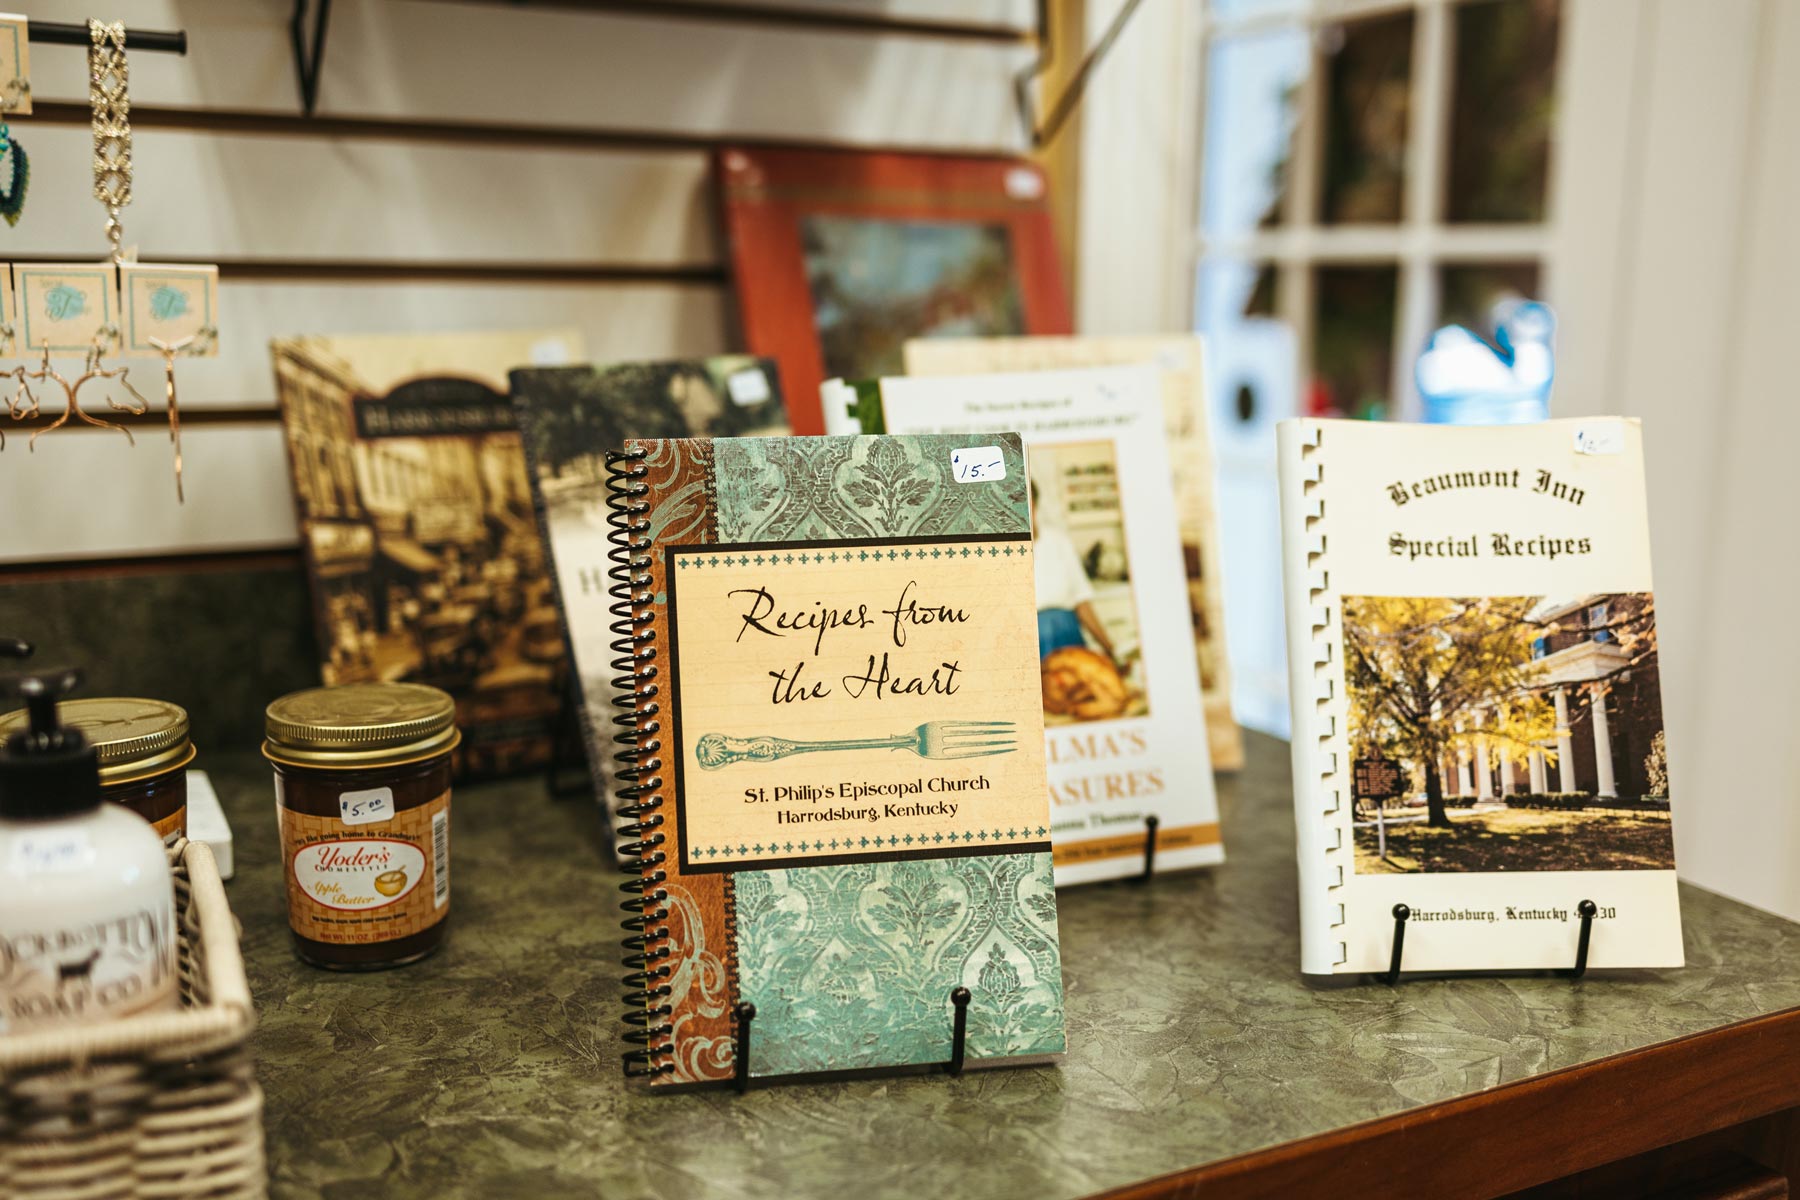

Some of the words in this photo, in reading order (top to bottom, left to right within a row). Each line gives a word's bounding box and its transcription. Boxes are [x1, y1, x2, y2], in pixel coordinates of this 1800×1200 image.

[1385, 467, 1520, 507] Beaumont
[1532, 467, 1586, 507] Inn
[1387, 531, 1479, 561] Special
[1489, 531, 1592, 560] Recipes
[727, 585, 875, 657] Recipes
[881, 580, 971, 648] from
[768, 661, 832, 705] the
[842, 652, 963, 701] Heart
[743, 787, 769, 804] St.
[773, 783, 836, 804] Philip's
[838, 777, 925, 802] Episcopal
[927, 774, 991, 794] Church
[777, 806, 882, 824] Harrodsburg,
[884, 801, 960, 819] Kentucky
[342, 830, 365, 838] home
[314, 846, 391, 872] Yoder's
[331, 893, 375, 905] Butter
[1409, 907, 1500, 923] Harrodsburg,
[1505, 905, 1569, 922] Kentucky
